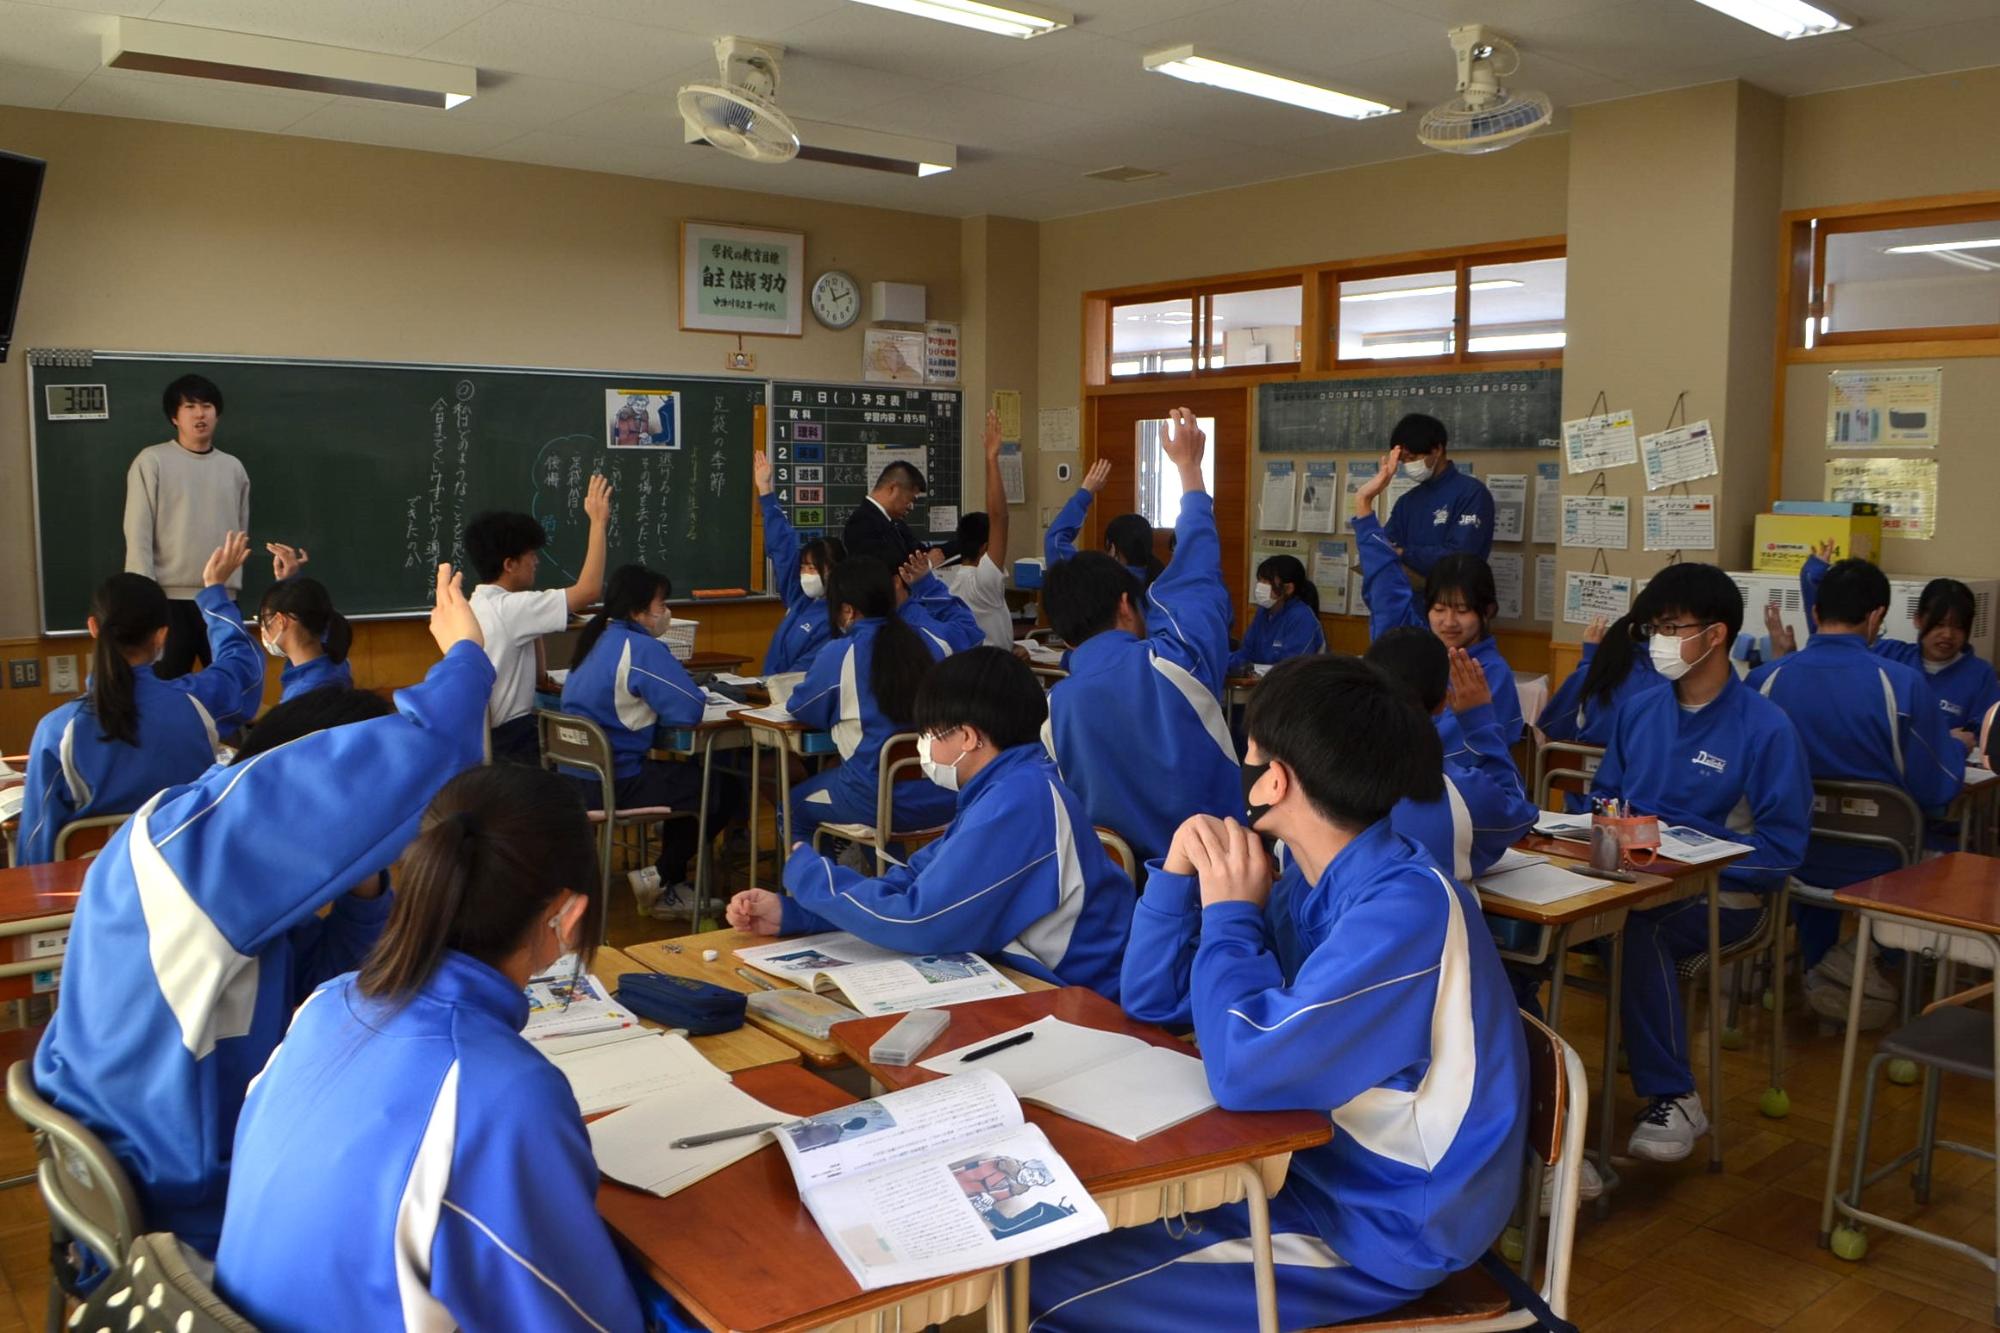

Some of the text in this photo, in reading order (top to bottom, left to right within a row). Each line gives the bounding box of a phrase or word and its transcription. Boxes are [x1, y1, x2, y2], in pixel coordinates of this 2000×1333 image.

[711, 243, 780, 265] 学校の教育目標
[703, 265, 787, 294] 自主 信頼 努力
[779, 426, 785, 438] 1
[778, 448, 788, 459] 2
[778, 470, 788, 481] 3
[778, 489, 788, 501] 4
